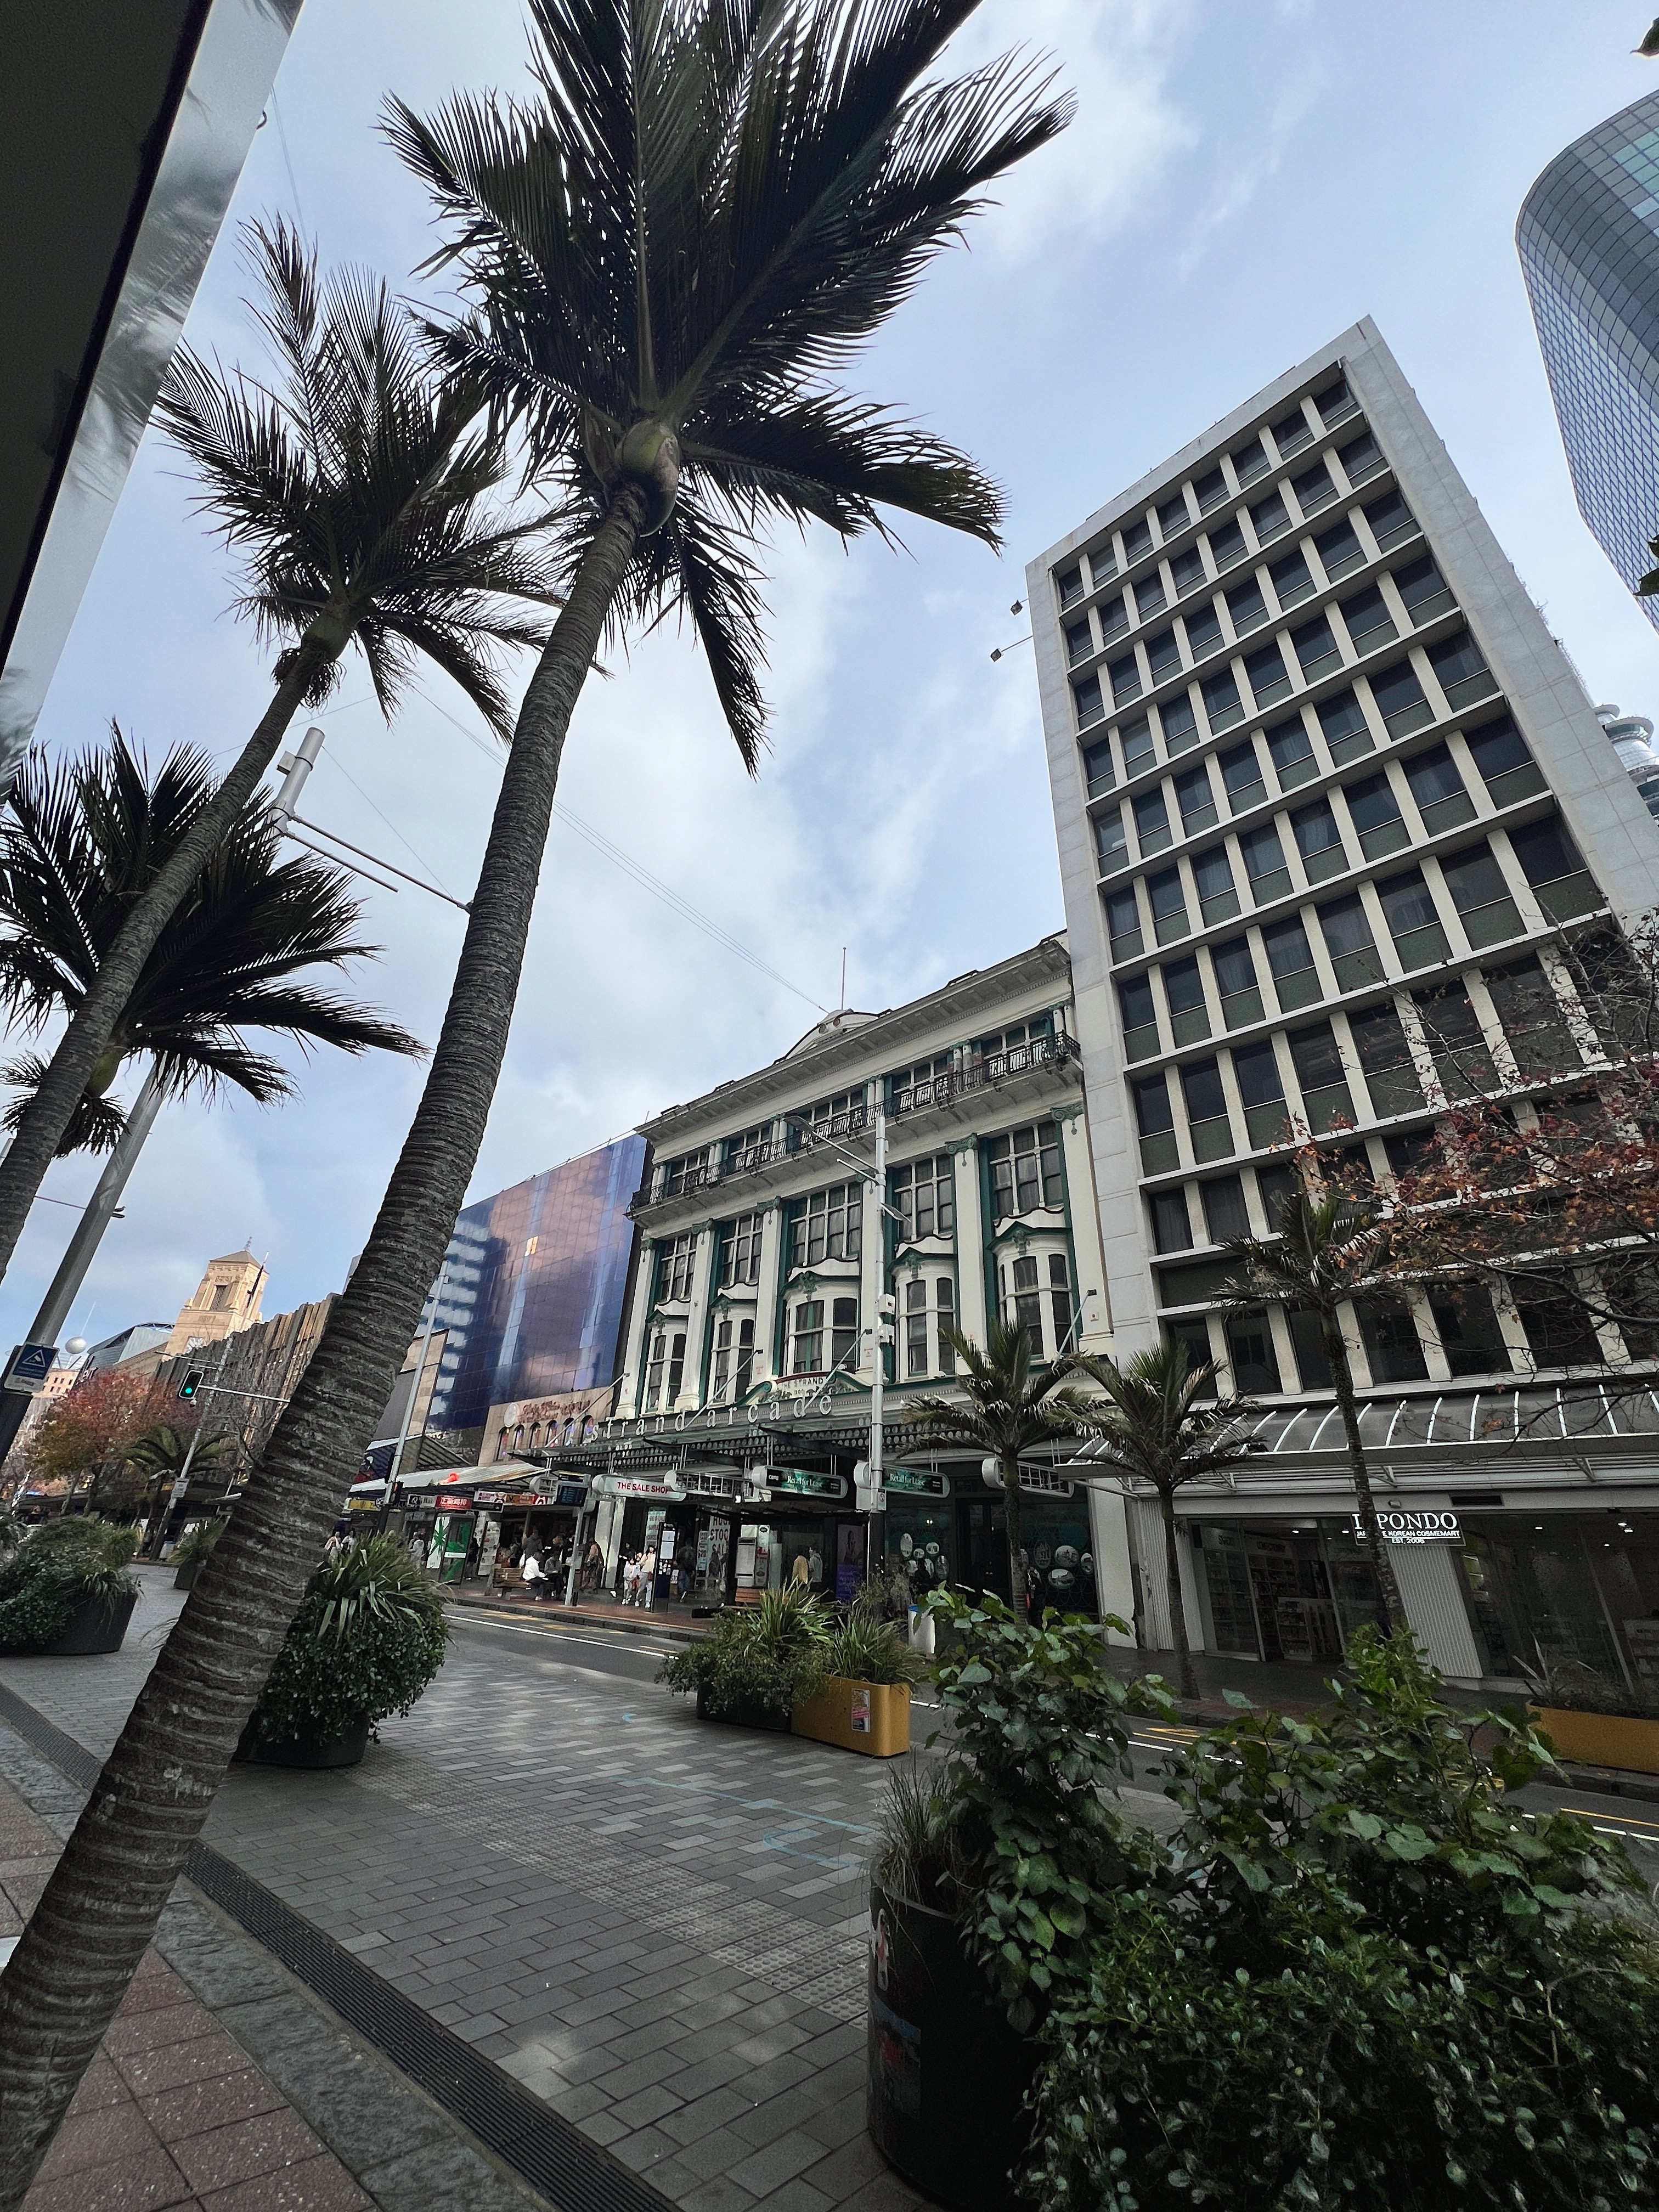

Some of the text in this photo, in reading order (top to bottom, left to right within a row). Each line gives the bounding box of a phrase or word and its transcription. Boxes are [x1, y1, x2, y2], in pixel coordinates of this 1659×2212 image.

[794, 1377, 823, 1387] STRAND
[591, 1412, 687, 1442] strand
[706, 1390, 833, 1427] arcade
[787, 1475, 802, 1485] Retail
[802, 1477, 810, 1486] for
[810, 1479, 823, 1487] Lease
[890, 1473, 904, 1482] Retail
[912, 1476, 927, 1486] Lease
[632, 1483, 650, 1492] SALE
[714, 1516, 729, 1526] HUG
[1352, 1512, 1458, 1530] IPONDO
[709, 1528, 729, 1541] STOC
[712, 1543, 727, 1555] SAL
